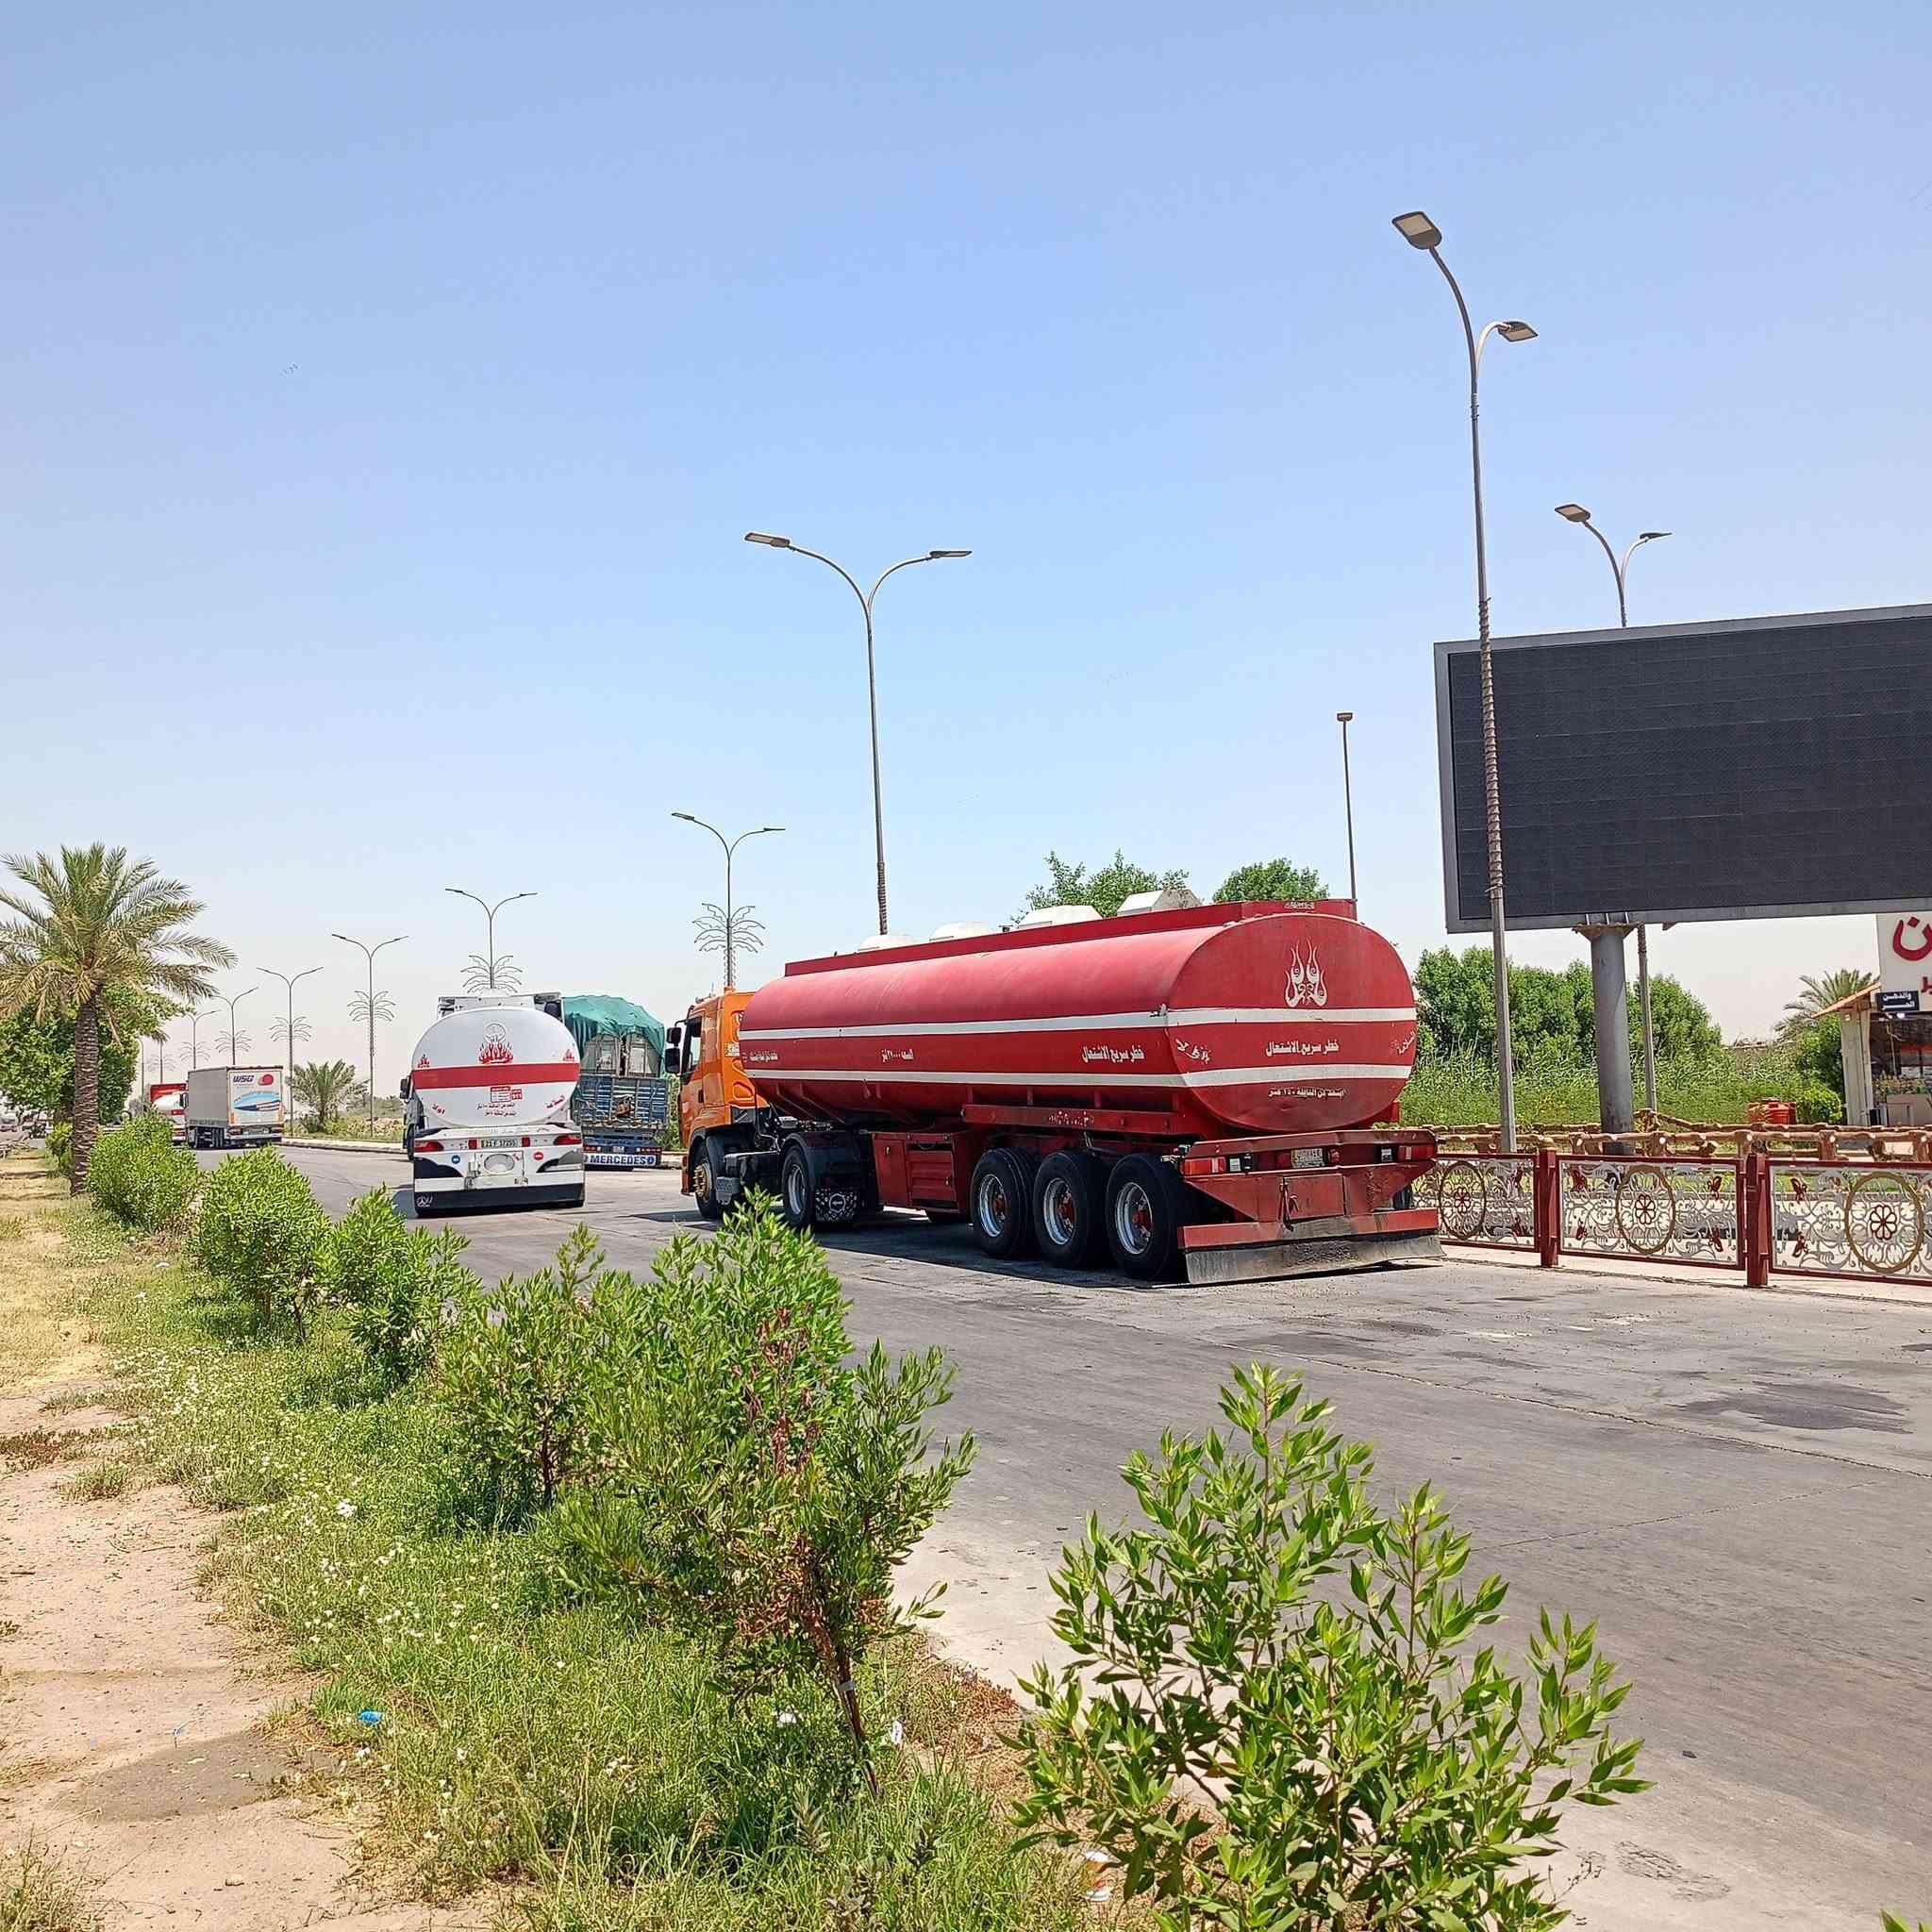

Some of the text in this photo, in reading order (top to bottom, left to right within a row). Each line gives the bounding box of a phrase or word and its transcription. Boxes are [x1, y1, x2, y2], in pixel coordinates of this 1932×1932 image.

[1082, 1044, 1144, 1063] خطر سريع الاشتعال
[1265, 1039, 1340, 1057] خطر سريع الاشتعال
[590, 1155, 646, 1165] MERCEDES
